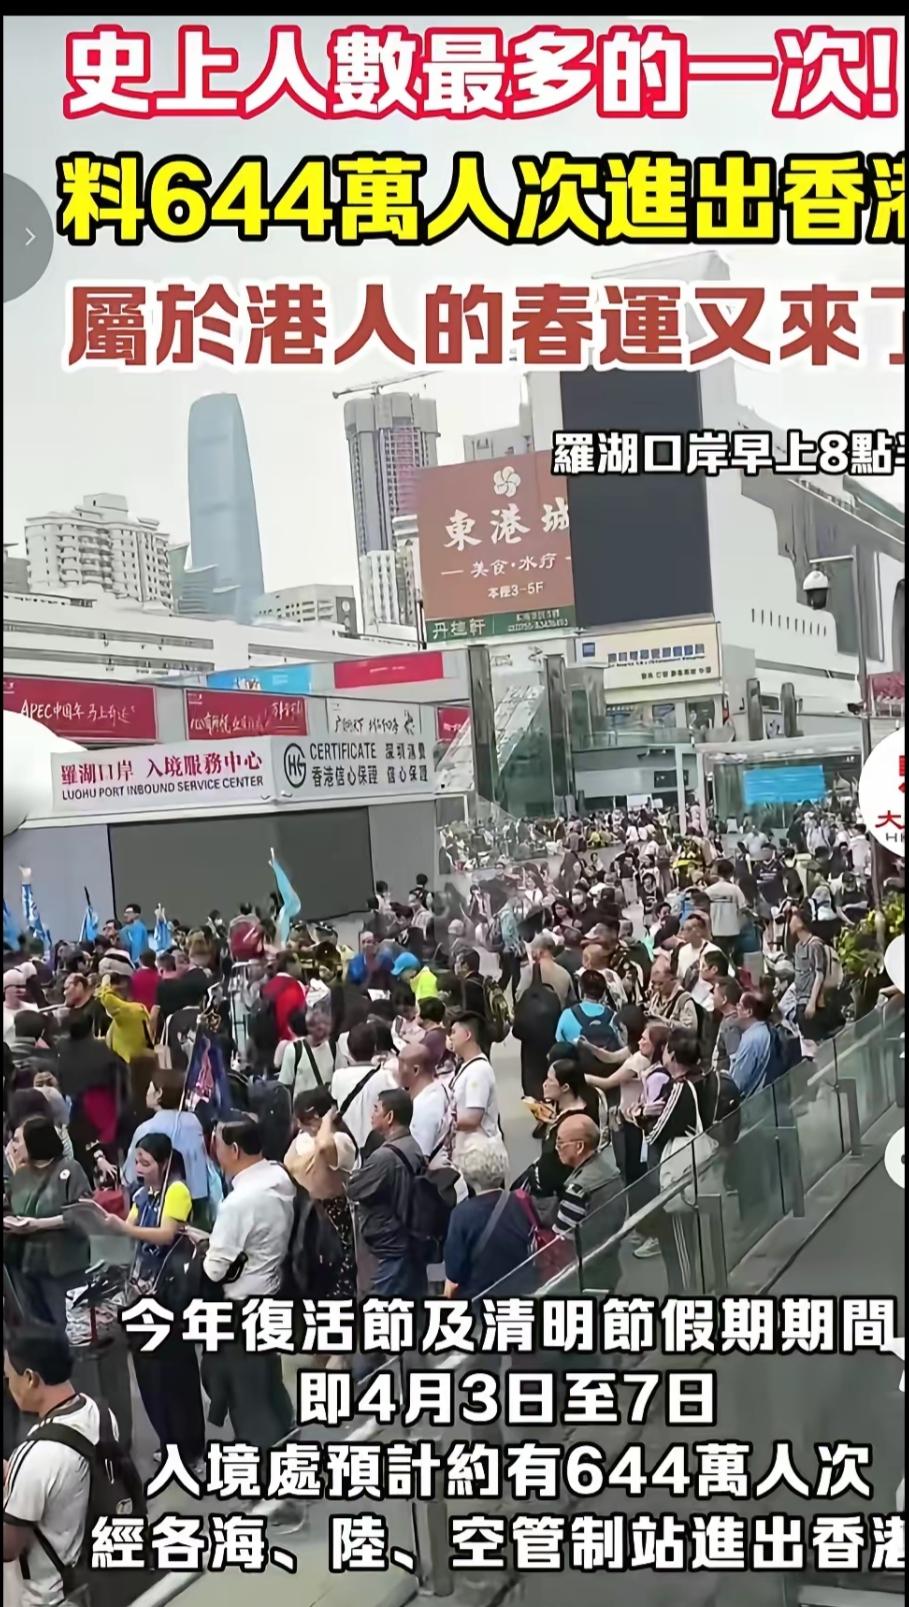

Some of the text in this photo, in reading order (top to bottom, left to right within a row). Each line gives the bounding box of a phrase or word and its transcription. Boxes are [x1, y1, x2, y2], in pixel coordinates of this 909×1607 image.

[444, 497, 569, 551] 東港城
[310, 742, 377, 760] CERTIFICATE
[61, 750, 263, 785] 羅湖口岸 入境服務中心
[62, 775, 264, 800] LUOHU PORT INBOUND SERVICE CENTER
